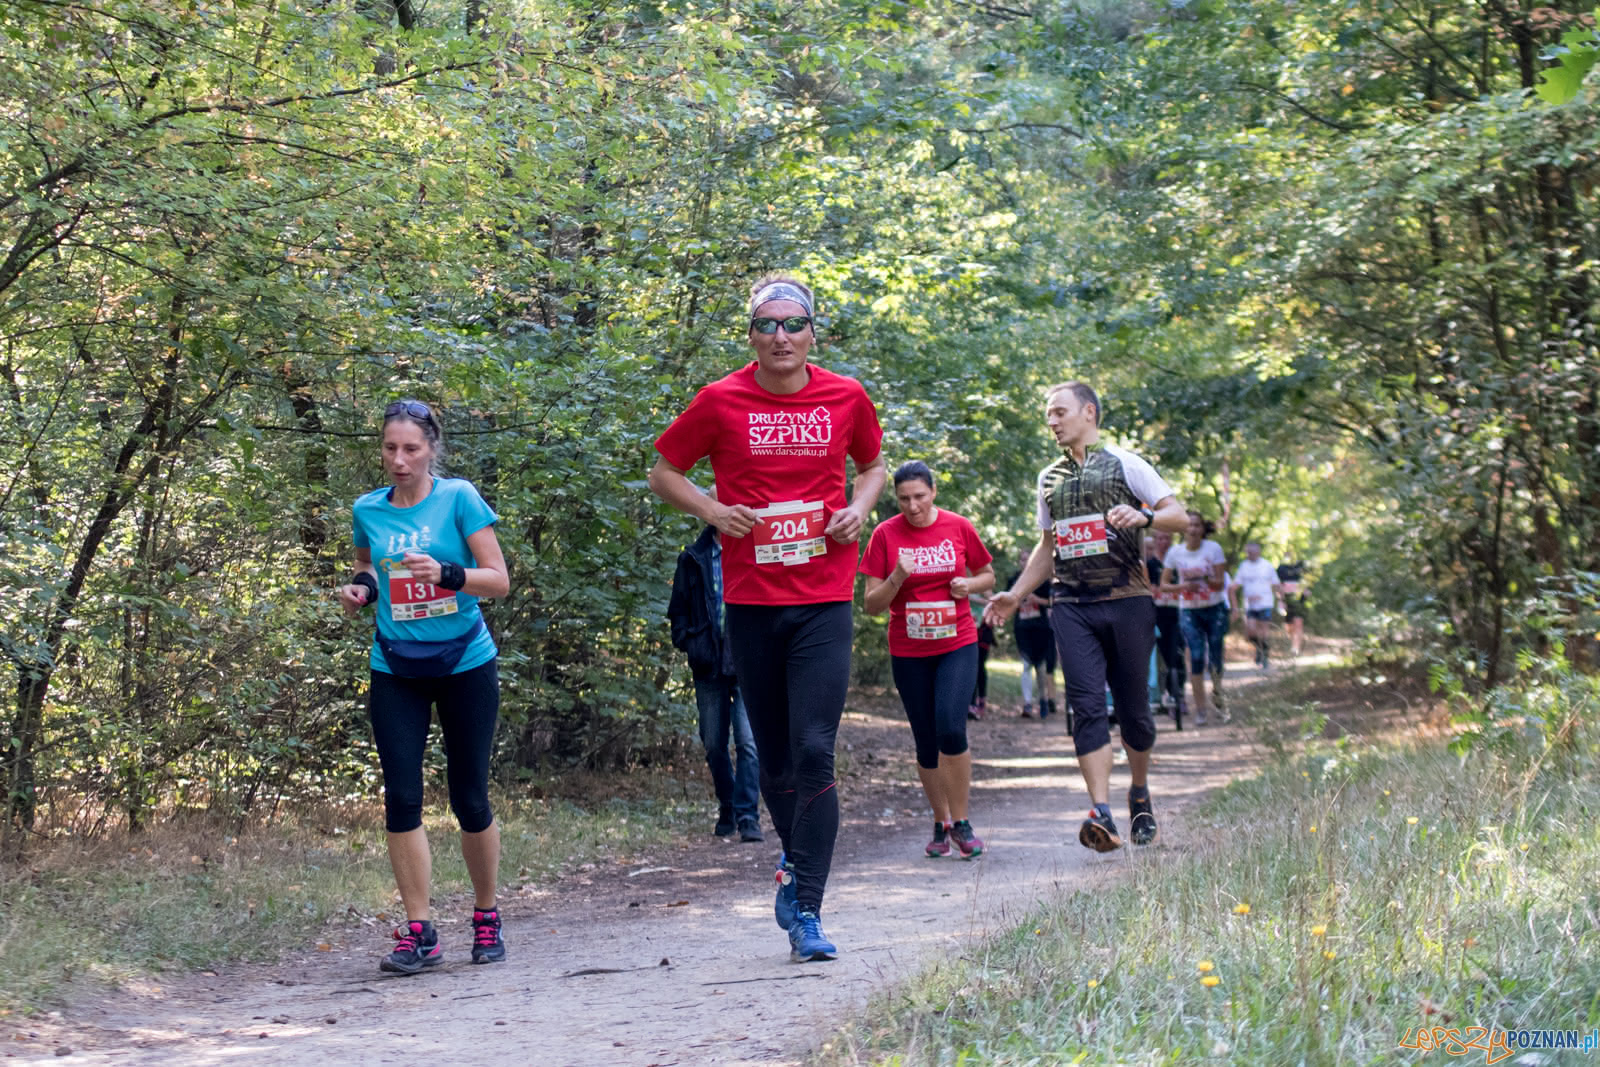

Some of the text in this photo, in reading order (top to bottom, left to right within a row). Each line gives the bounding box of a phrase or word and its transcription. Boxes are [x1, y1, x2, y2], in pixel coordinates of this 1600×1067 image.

[748, 411, 818, 424] DRUŻYNA
[749, 424, 832, 445] SZPIKU
[751, 447, 827, 457] www.darszpiku.pl
[770, 517, 809, 540] 204
[1067, 526, 1092, 542] 366
[405, 583, 436, 600] 131
[919, 611, 943, 625] 121
